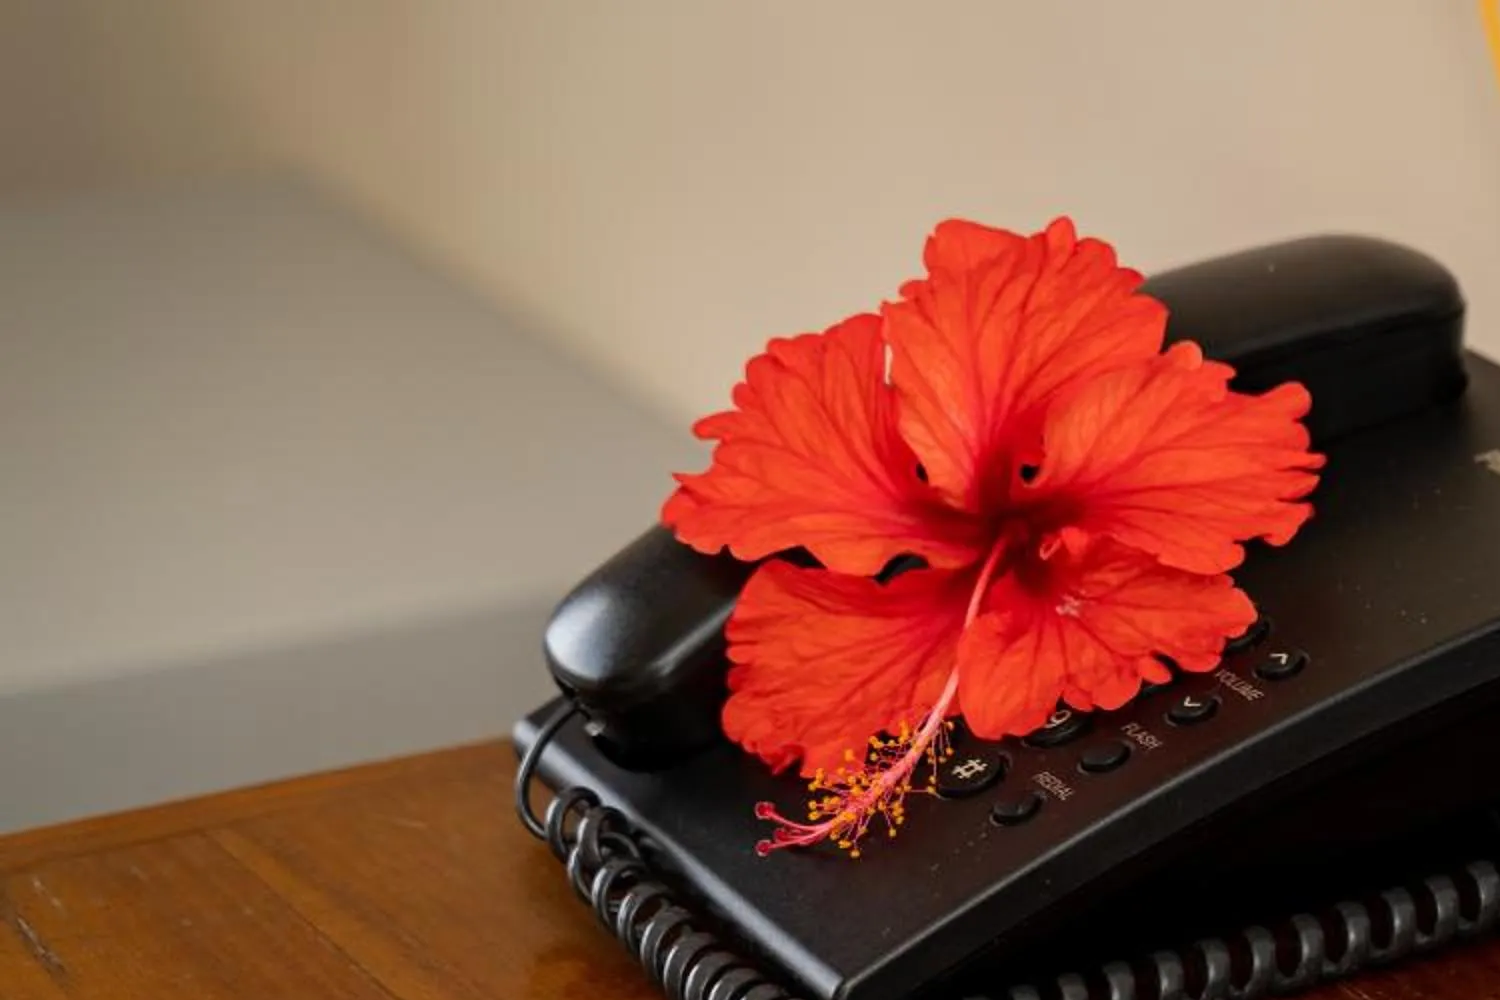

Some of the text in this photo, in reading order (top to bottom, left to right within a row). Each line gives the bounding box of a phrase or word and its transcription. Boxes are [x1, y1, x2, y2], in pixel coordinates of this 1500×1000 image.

[1214, 669, 1265, 701] VOLUME
[1121, 722, 1163, 750] FLASH
[1032, 771, 1075, 801] REDIAL
